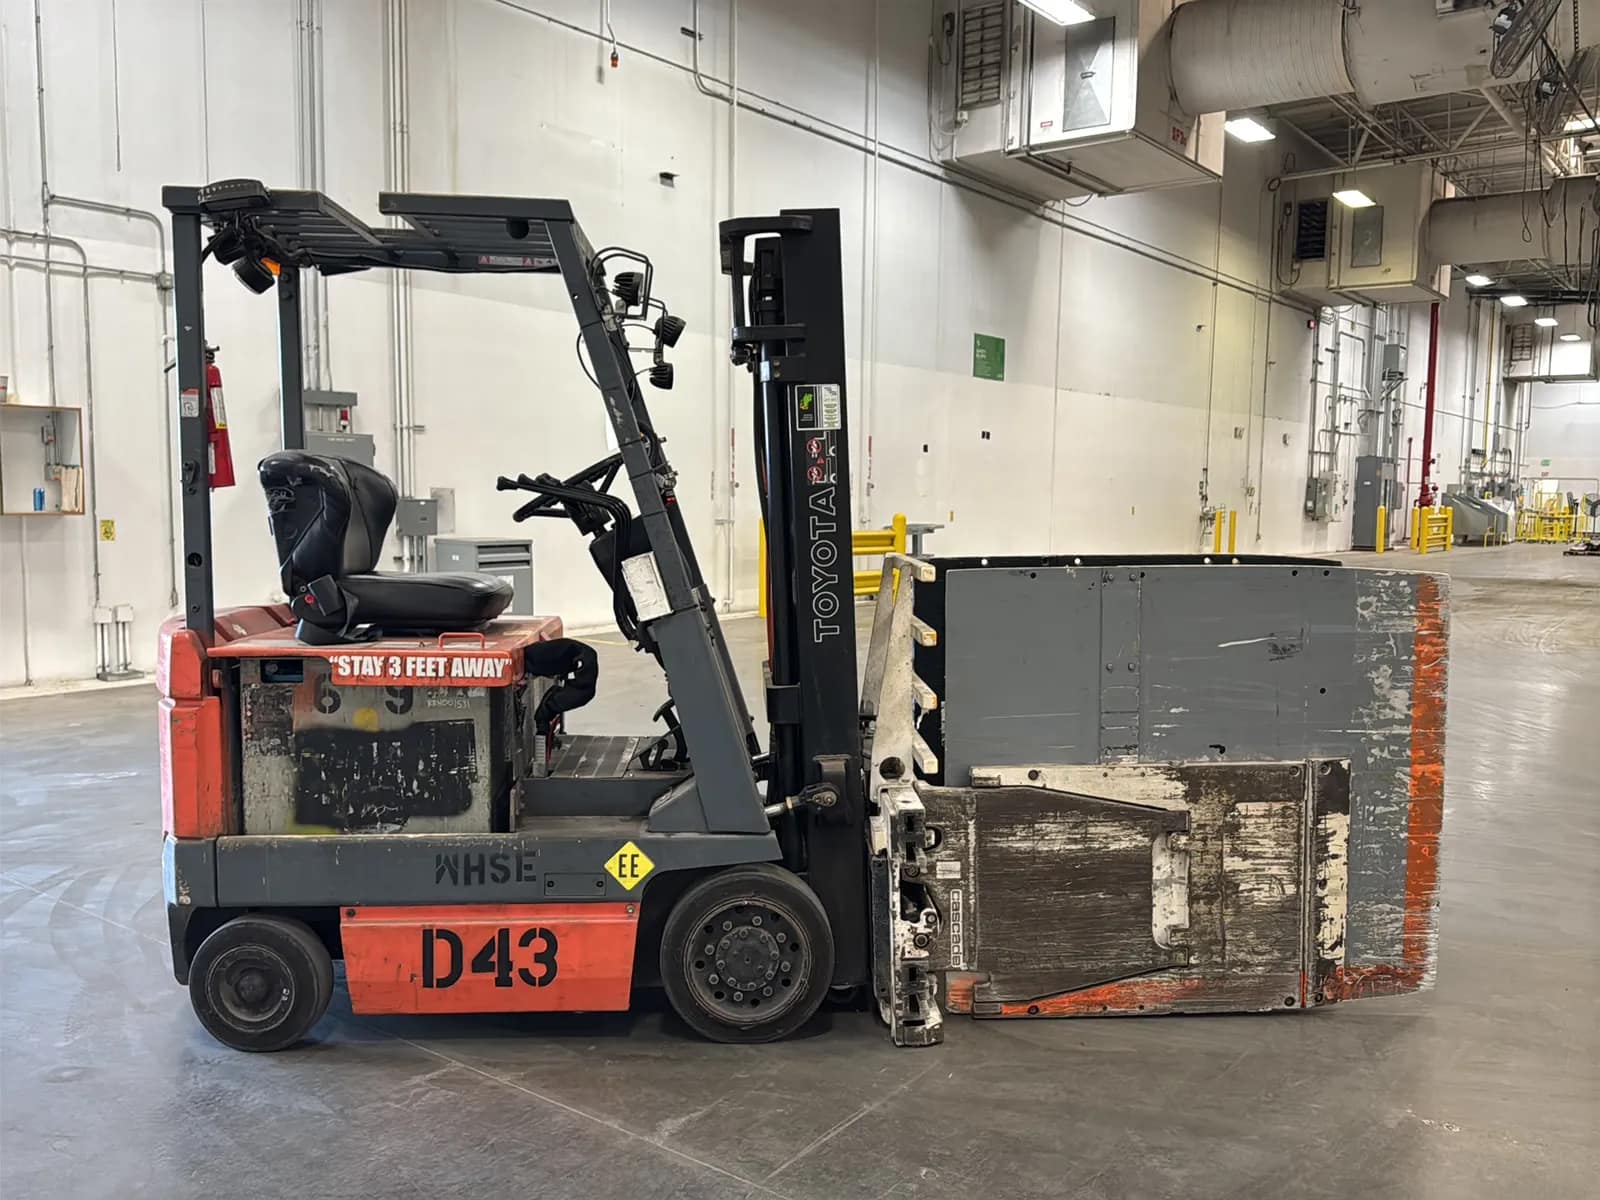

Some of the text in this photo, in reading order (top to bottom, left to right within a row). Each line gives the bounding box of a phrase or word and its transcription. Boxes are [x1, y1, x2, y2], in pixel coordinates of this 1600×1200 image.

[809, 486, 840, 643] TOYOTA
[388, 655, 402, 677] 3
[406, 656, 447, 677] FEET
[434, 851, 537, 886] WHSE
[618, 853, 640, 878] EE
[951, 889, 963, 967] cascade
[422, 927, 558, 989] D43
